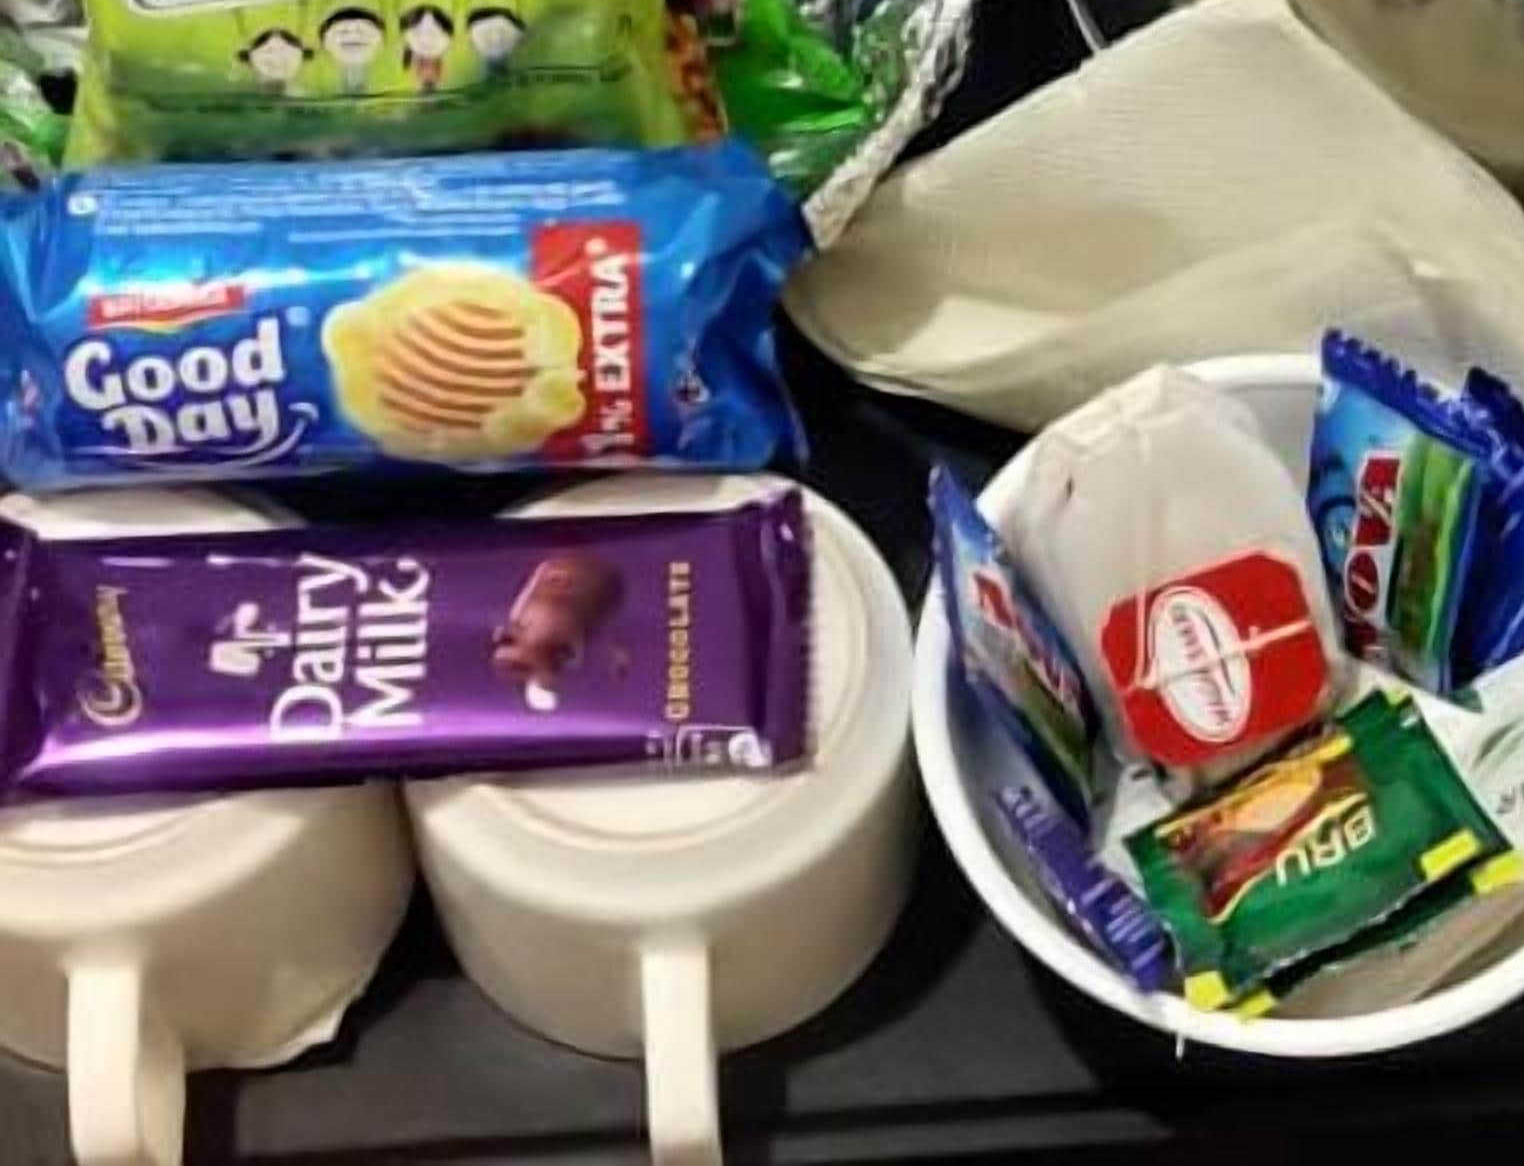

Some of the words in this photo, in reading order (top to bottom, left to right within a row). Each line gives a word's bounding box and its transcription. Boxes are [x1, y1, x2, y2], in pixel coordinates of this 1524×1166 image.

[65, 317, 287, 411] Good
[590, 252, 631, 392] EXTRA
[102, 389, 281, 455] Day
[268, 551, 370, 742] Dairy
[347, 558, 430, 726] Milk
[1275, 803, 1376, 886] BRU
